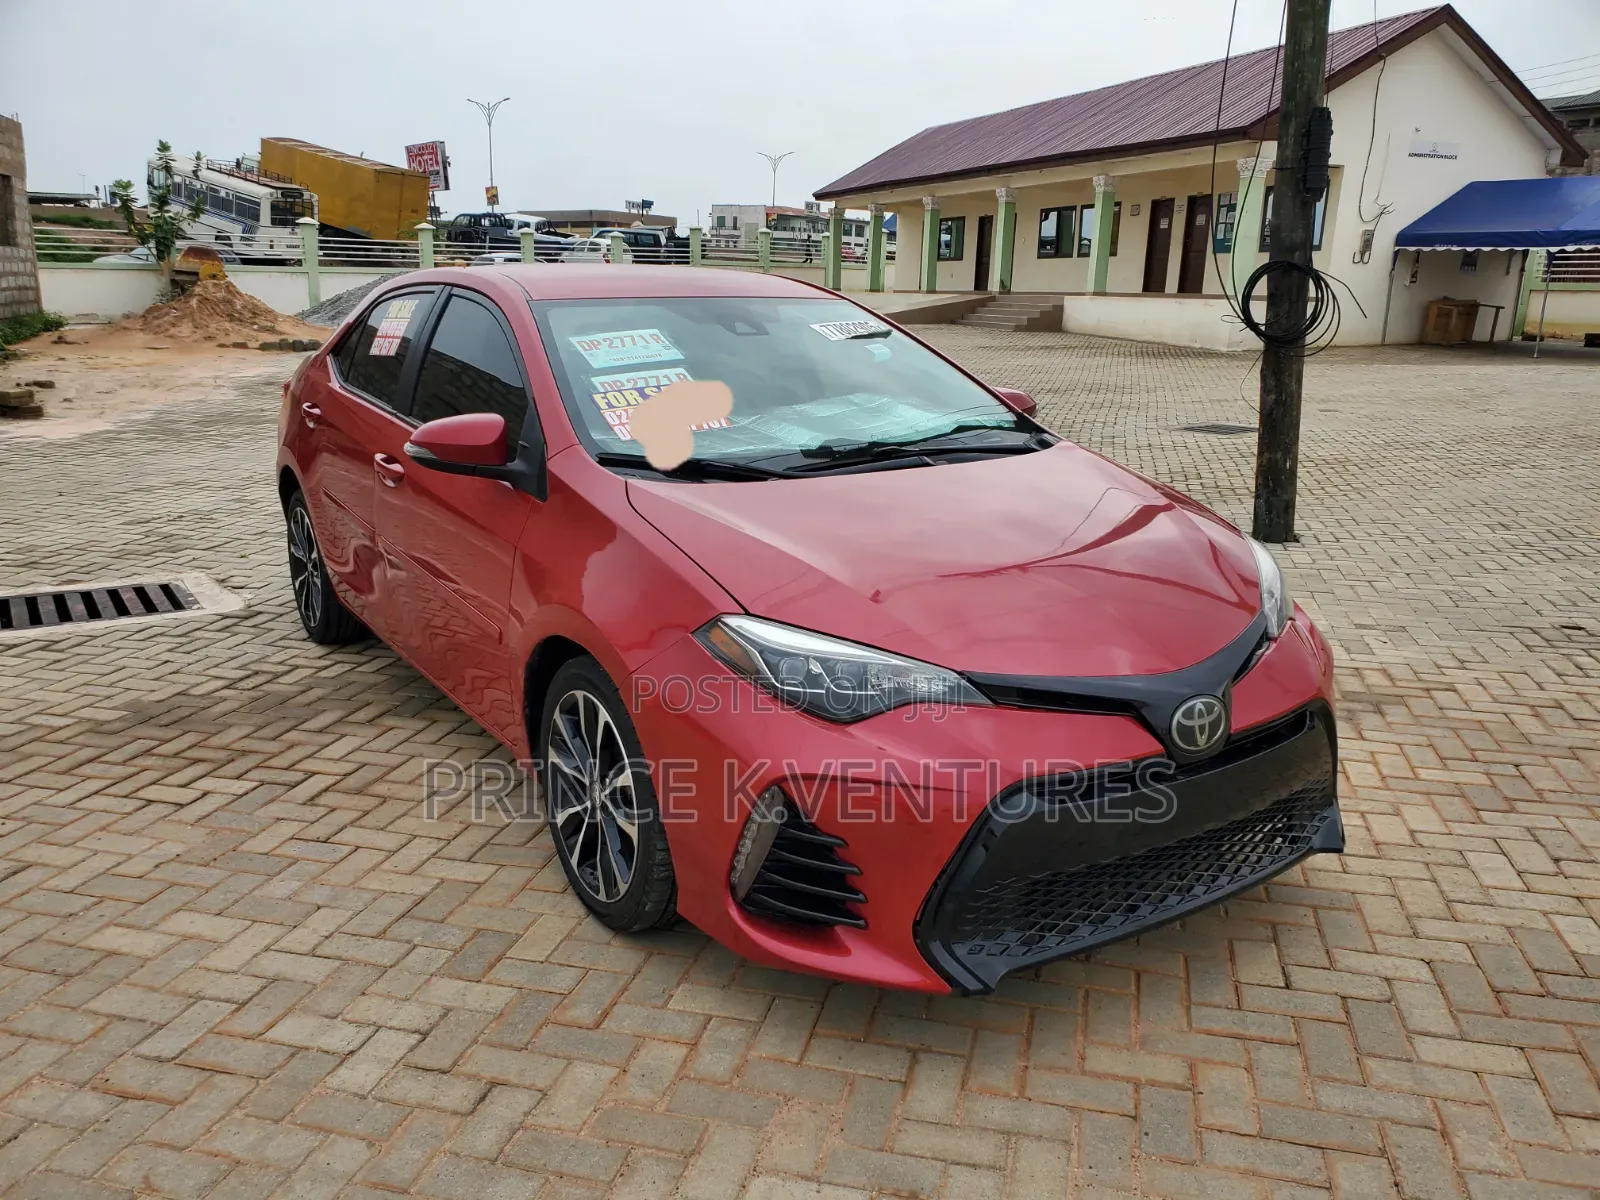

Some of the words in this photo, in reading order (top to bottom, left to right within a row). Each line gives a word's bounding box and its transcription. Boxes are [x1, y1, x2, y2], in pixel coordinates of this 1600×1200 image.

[410, 154, 440, 173] HOTEL
[576, 340, 603, 352] DP
[602, 335, 652, 349] 2771
[592, 389, 645, 410] FOR
